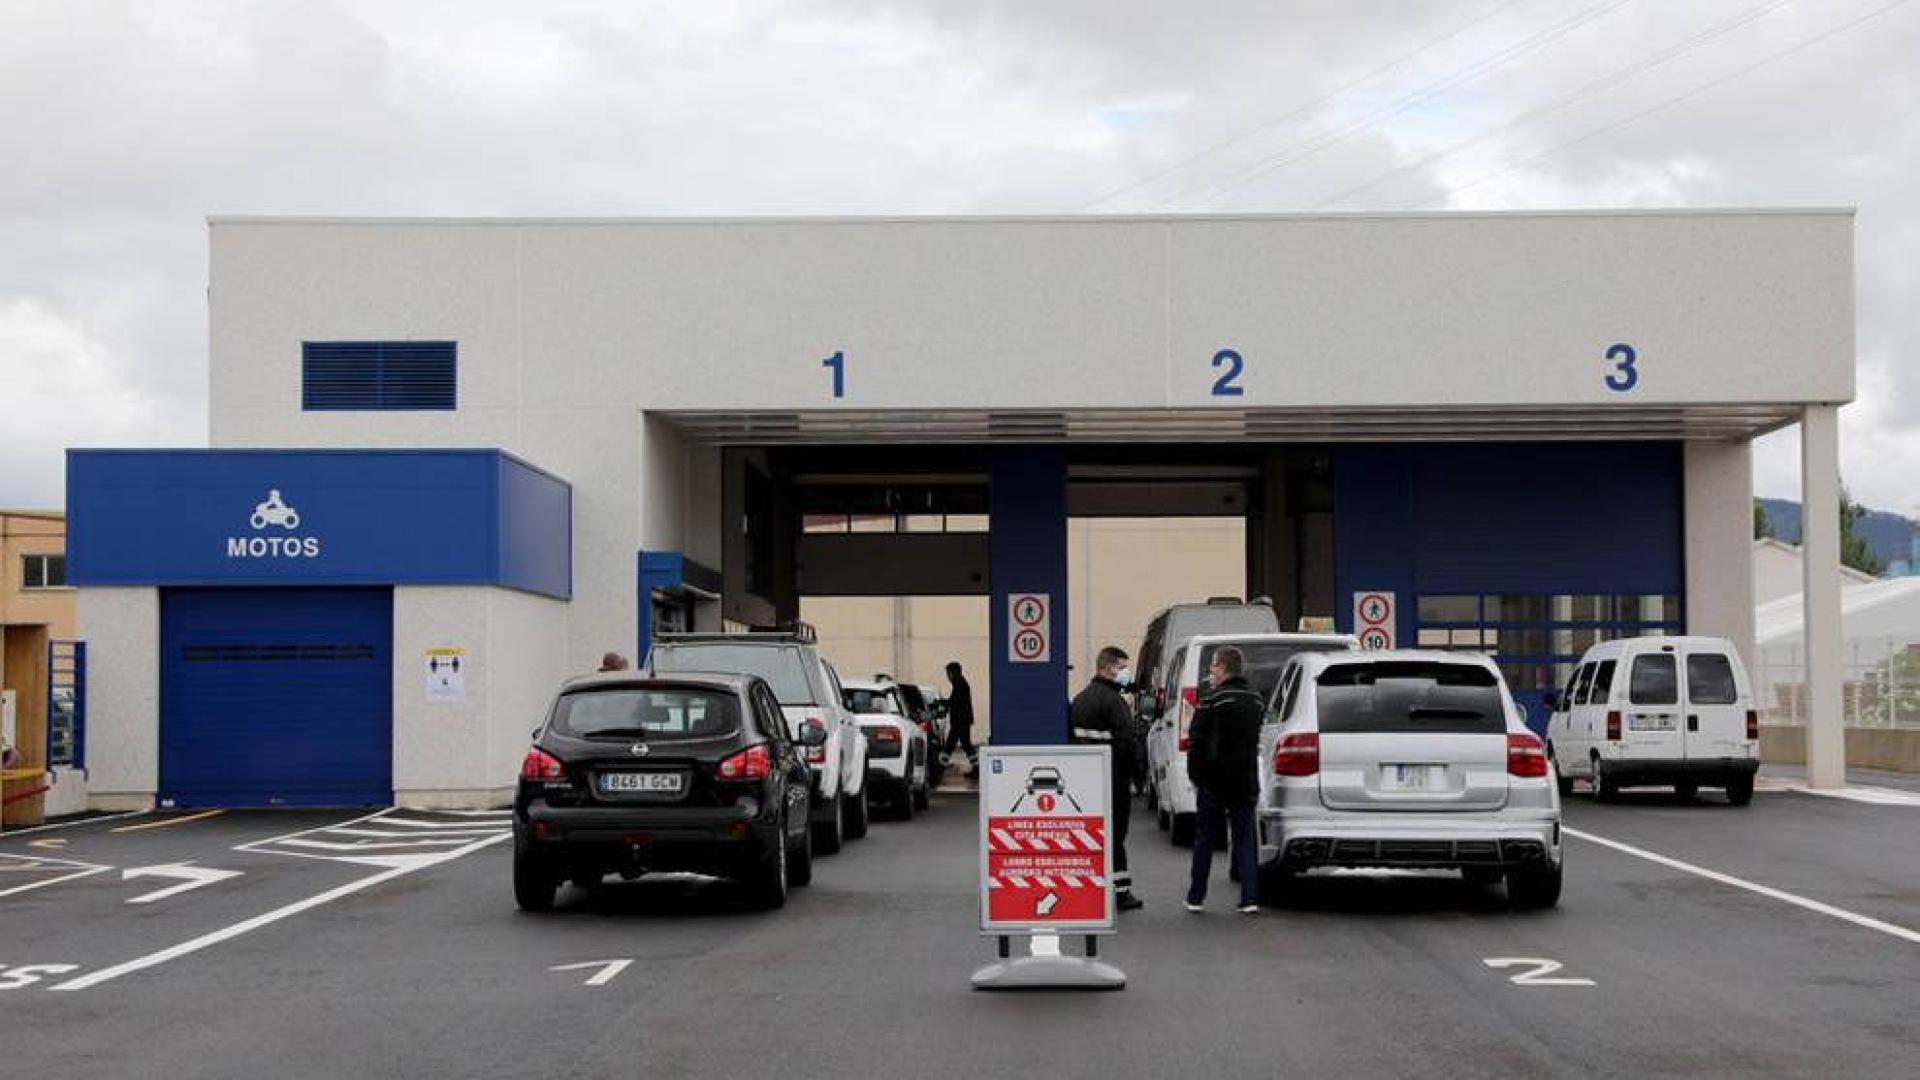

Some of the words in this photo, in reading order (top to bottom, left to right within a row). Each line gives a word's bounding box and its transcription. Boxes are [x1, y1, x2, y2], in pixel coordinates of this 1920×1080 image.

[822, 351, 844, 398] 1
[1212, 350, 1243, 396] 2
[1605, 343, 1636, 391] 3
[228, 537, 319, 557] MOTOS
[1022, 637, 1038, 651] 10
[548, 959, 634, 985] 1
[1483, 957, 1597, 985] 2
